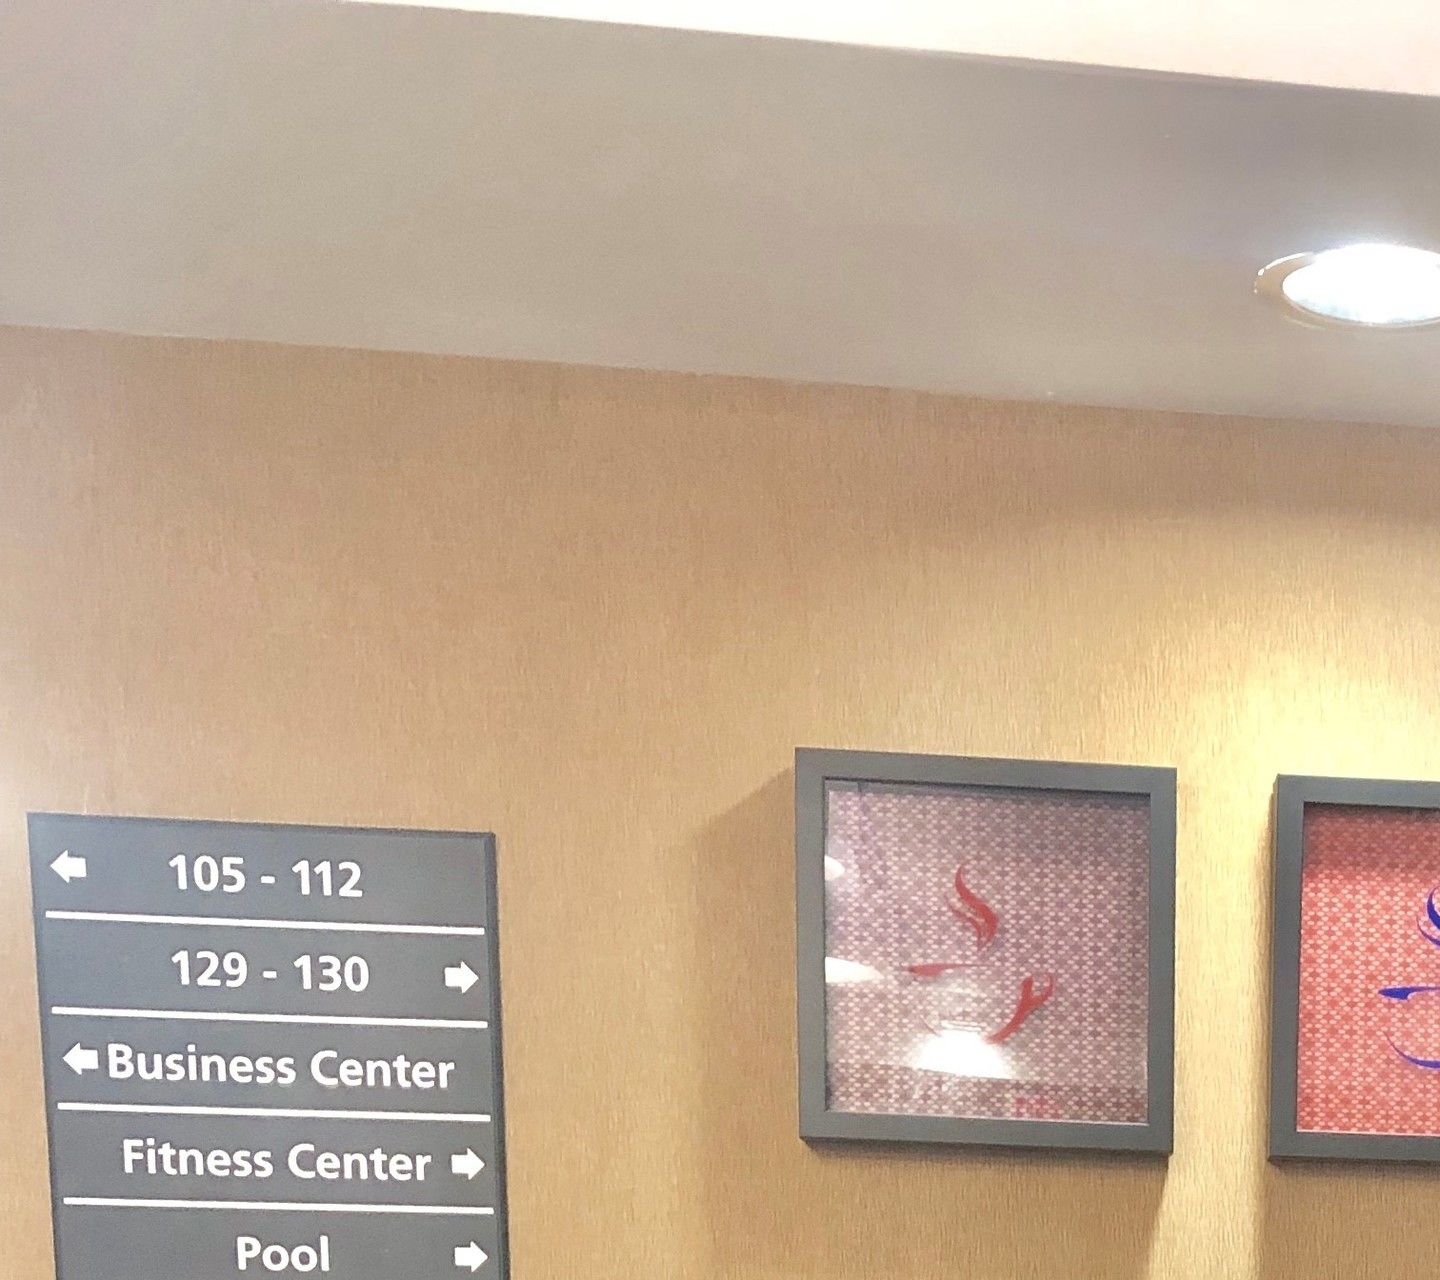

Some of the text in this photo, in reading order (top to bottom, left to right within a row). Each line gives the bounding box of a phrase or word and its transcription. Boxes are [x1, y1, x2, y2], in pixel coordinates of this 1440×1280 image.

[168, 855, 247, 893] 105
[291, 860, 364, 898] 112
[171, 950, 248, 987] 129
[293, 955, 370, 992] 130
[107, 1043, 456, 1088] Business Center
[123, 1138, 432, 1181] Fitness Center
[236, 1235, 331, 1273] Pool
